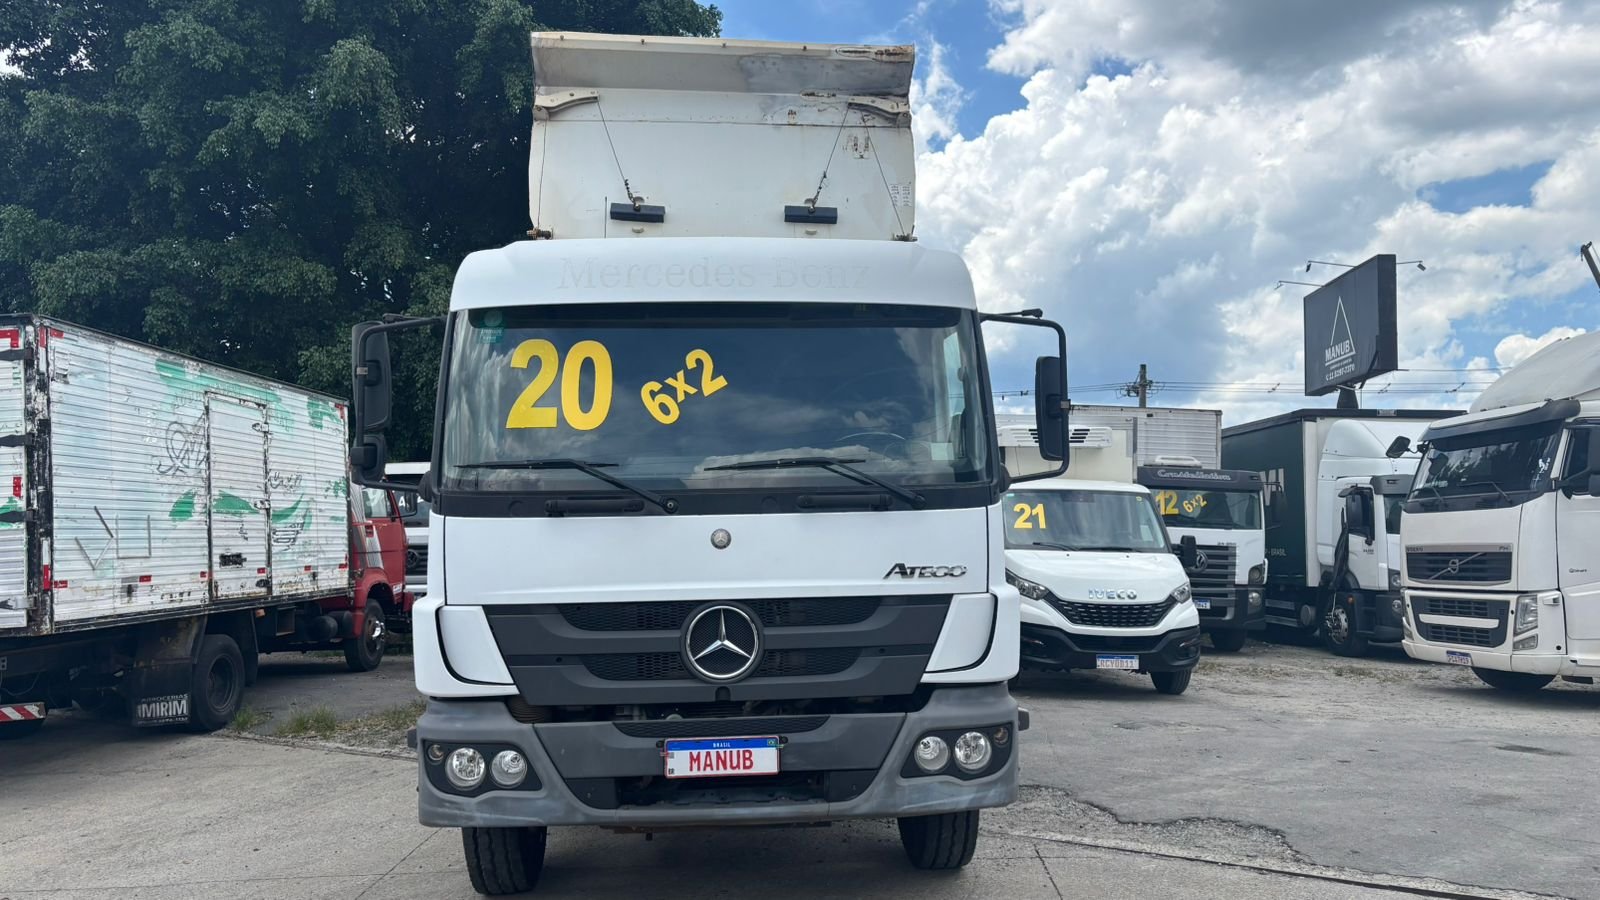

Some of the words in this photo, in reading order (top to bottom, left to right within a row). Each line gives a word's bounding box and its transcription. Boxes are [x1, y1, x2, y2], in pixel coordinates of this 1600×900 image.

[556, 256, 872, 289] Mercedes-Benz
[1325, 340, 1350, 362] MANUB
[505, 338, 613, 431] 20
[641, 348, 728, 425] 6x2
[1157, 470, 1231, 481] Constellation
[1155, 490, 1179, 515] 12
[1183, 494, 1207, 513] 6x2
[1013, 503, 1046, 529] 21
[1088, 589, 1138, 600] IVECO
[688, 749, 754, 772] MANUB
